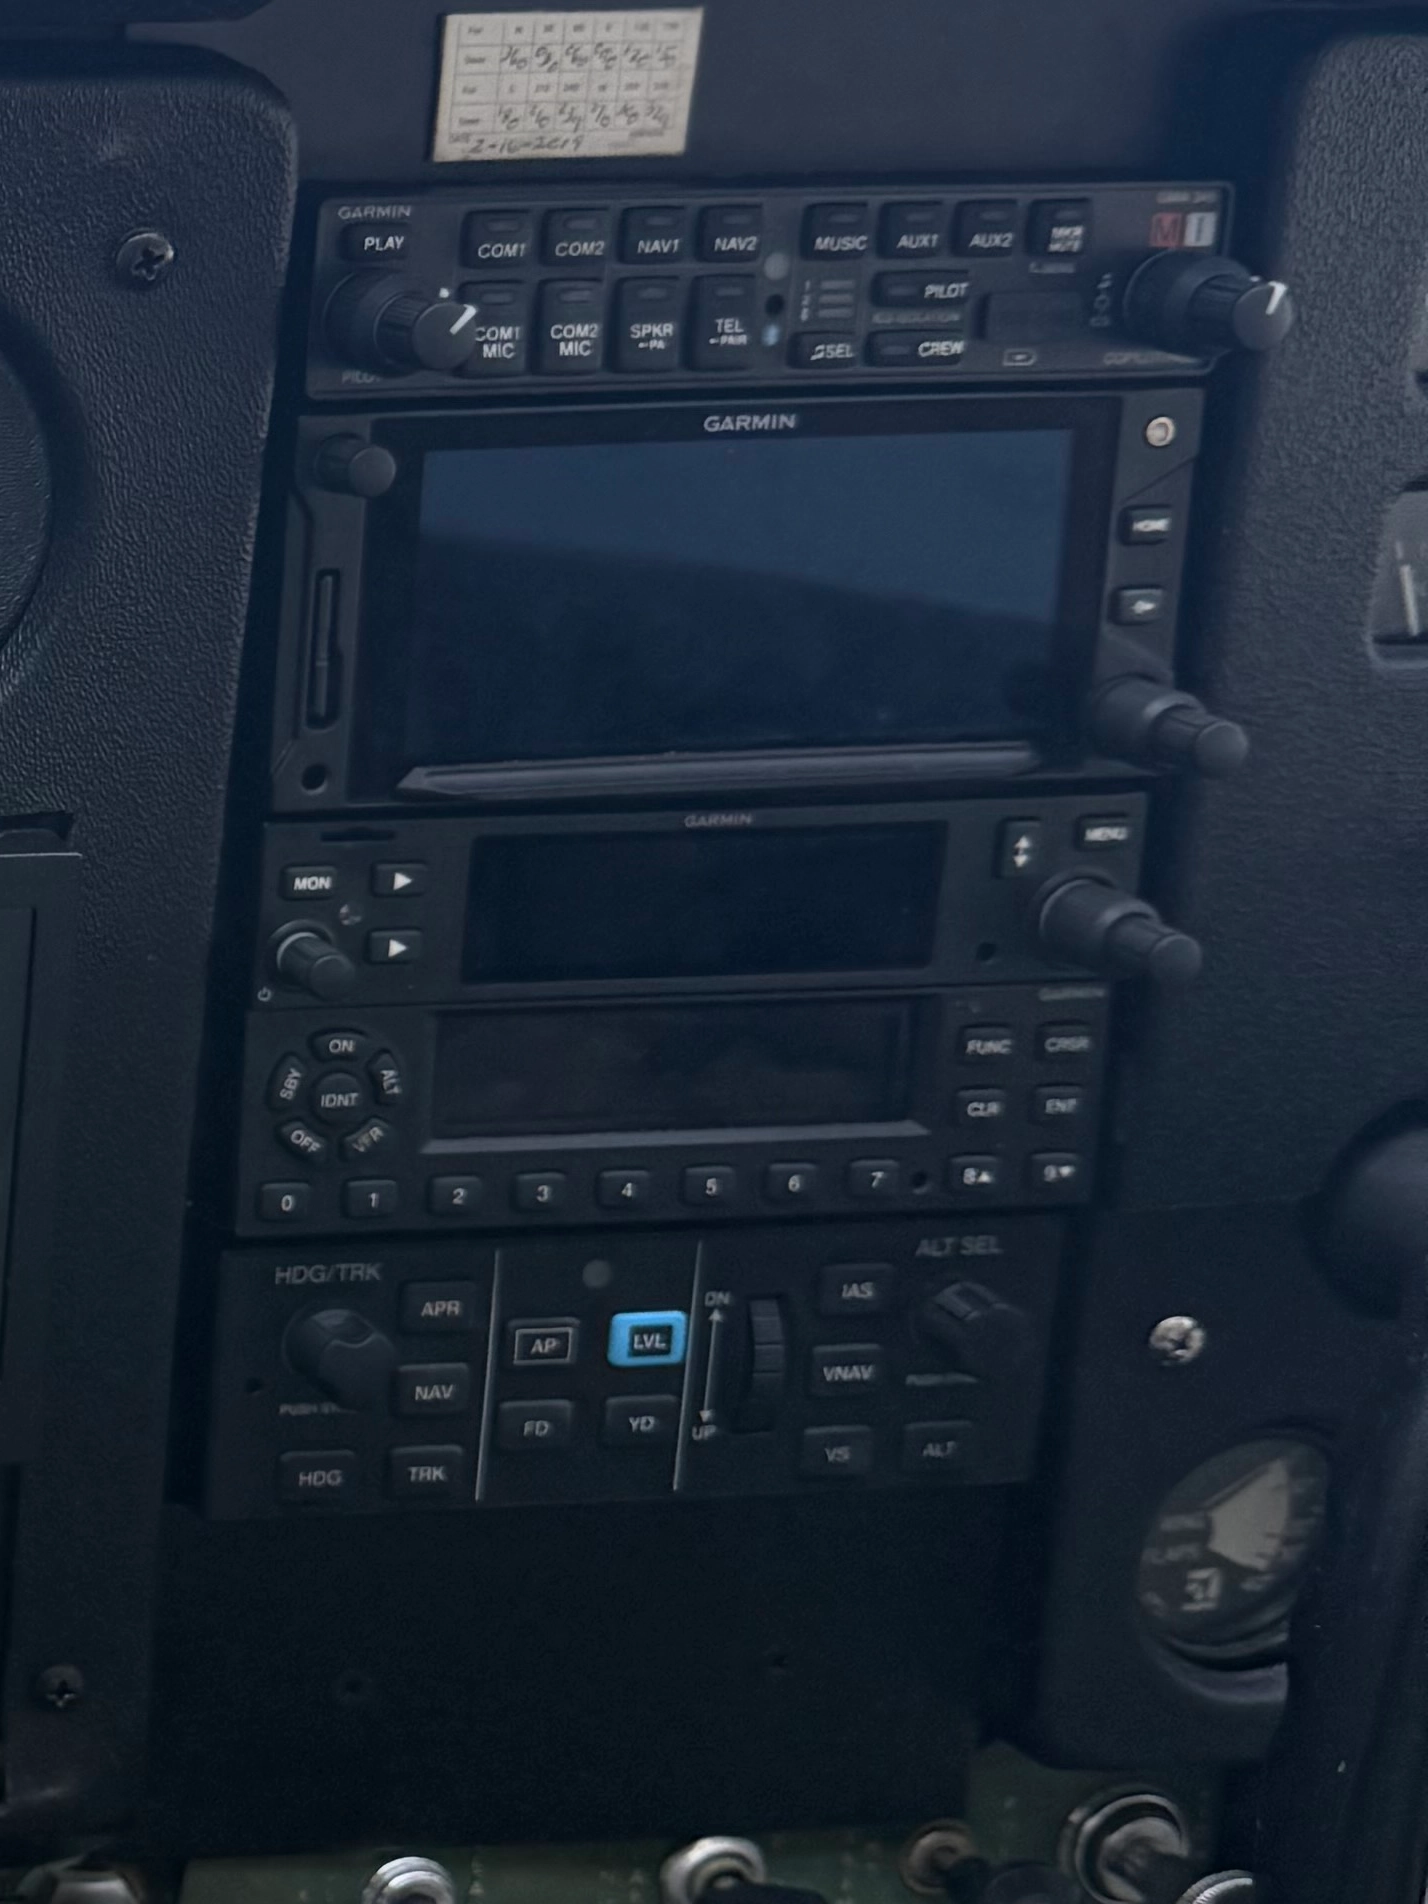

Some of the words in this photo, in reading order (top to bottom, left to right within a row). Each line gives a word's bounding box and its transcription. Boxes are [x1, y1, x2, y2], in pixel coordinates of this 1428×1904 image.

[338, 205, 412, 220] GARMIN
[363, 236, 405, 251] PLAY
[555, 240, 605, 256] COM2
[637, 238, 680, 254] NAV1
[713, 235, 758, 252] NAV2
[814, 234, 868, 252] MUSIC
[896, 233, 939, 249] AUX1
[968, 231, 1013, 248] AUX2
[477, 243, 526, 258] COM1
[923, 281, 969, 299] PILOT
[474, 326, 521, 341] COM1
[550, 323, 599, 339] COM2
[630, 322, 674, 338] SPKR
[715, 317, 745, 333] TEL
[482, 343, 516, 358] MIC
[559, 340, 592, 356] MIC
[703, 413, 796, 432] GARMIN
[684, 811, 754, 828] GARMIN
[293, 873, 332, 892] MON
[328, 1038, 356, 1055] ON
[278, 1067, 302, 1101] SBY
[320, 1092, 361, 1109] IDNT
[289, 1128, 324, 1154] OFF
[704, 1176, 718, 1197] 5
[787, 1173, 802, 1194] 6
[870, 1170, 887, 1189] 7
[452, 1186, 467, 1206] 2
[535, 1183, 552, 1203] 3
[621, 1180, 635, 1200] 4
[280, 1194, 294, 1213] 0
[959, 1235, 1005, 1256] SEL
[274, 1262, 385, 1286] HDG/TRK
[420, 1299, 461, 1319] APR
[529, 1337, 562, 1356] AP
[632, 1331, 669, 1351] LVL
[822, 1363, 876, 1383] VNAV
[414, 1384, 455, 1402] NAV
[522, 1419, 551, 1439] FD
[628, 1415, 656, 1433] YD
[297, 1469, 344, 1488] HDG
[407, 1465, 447, 1484] TRK
